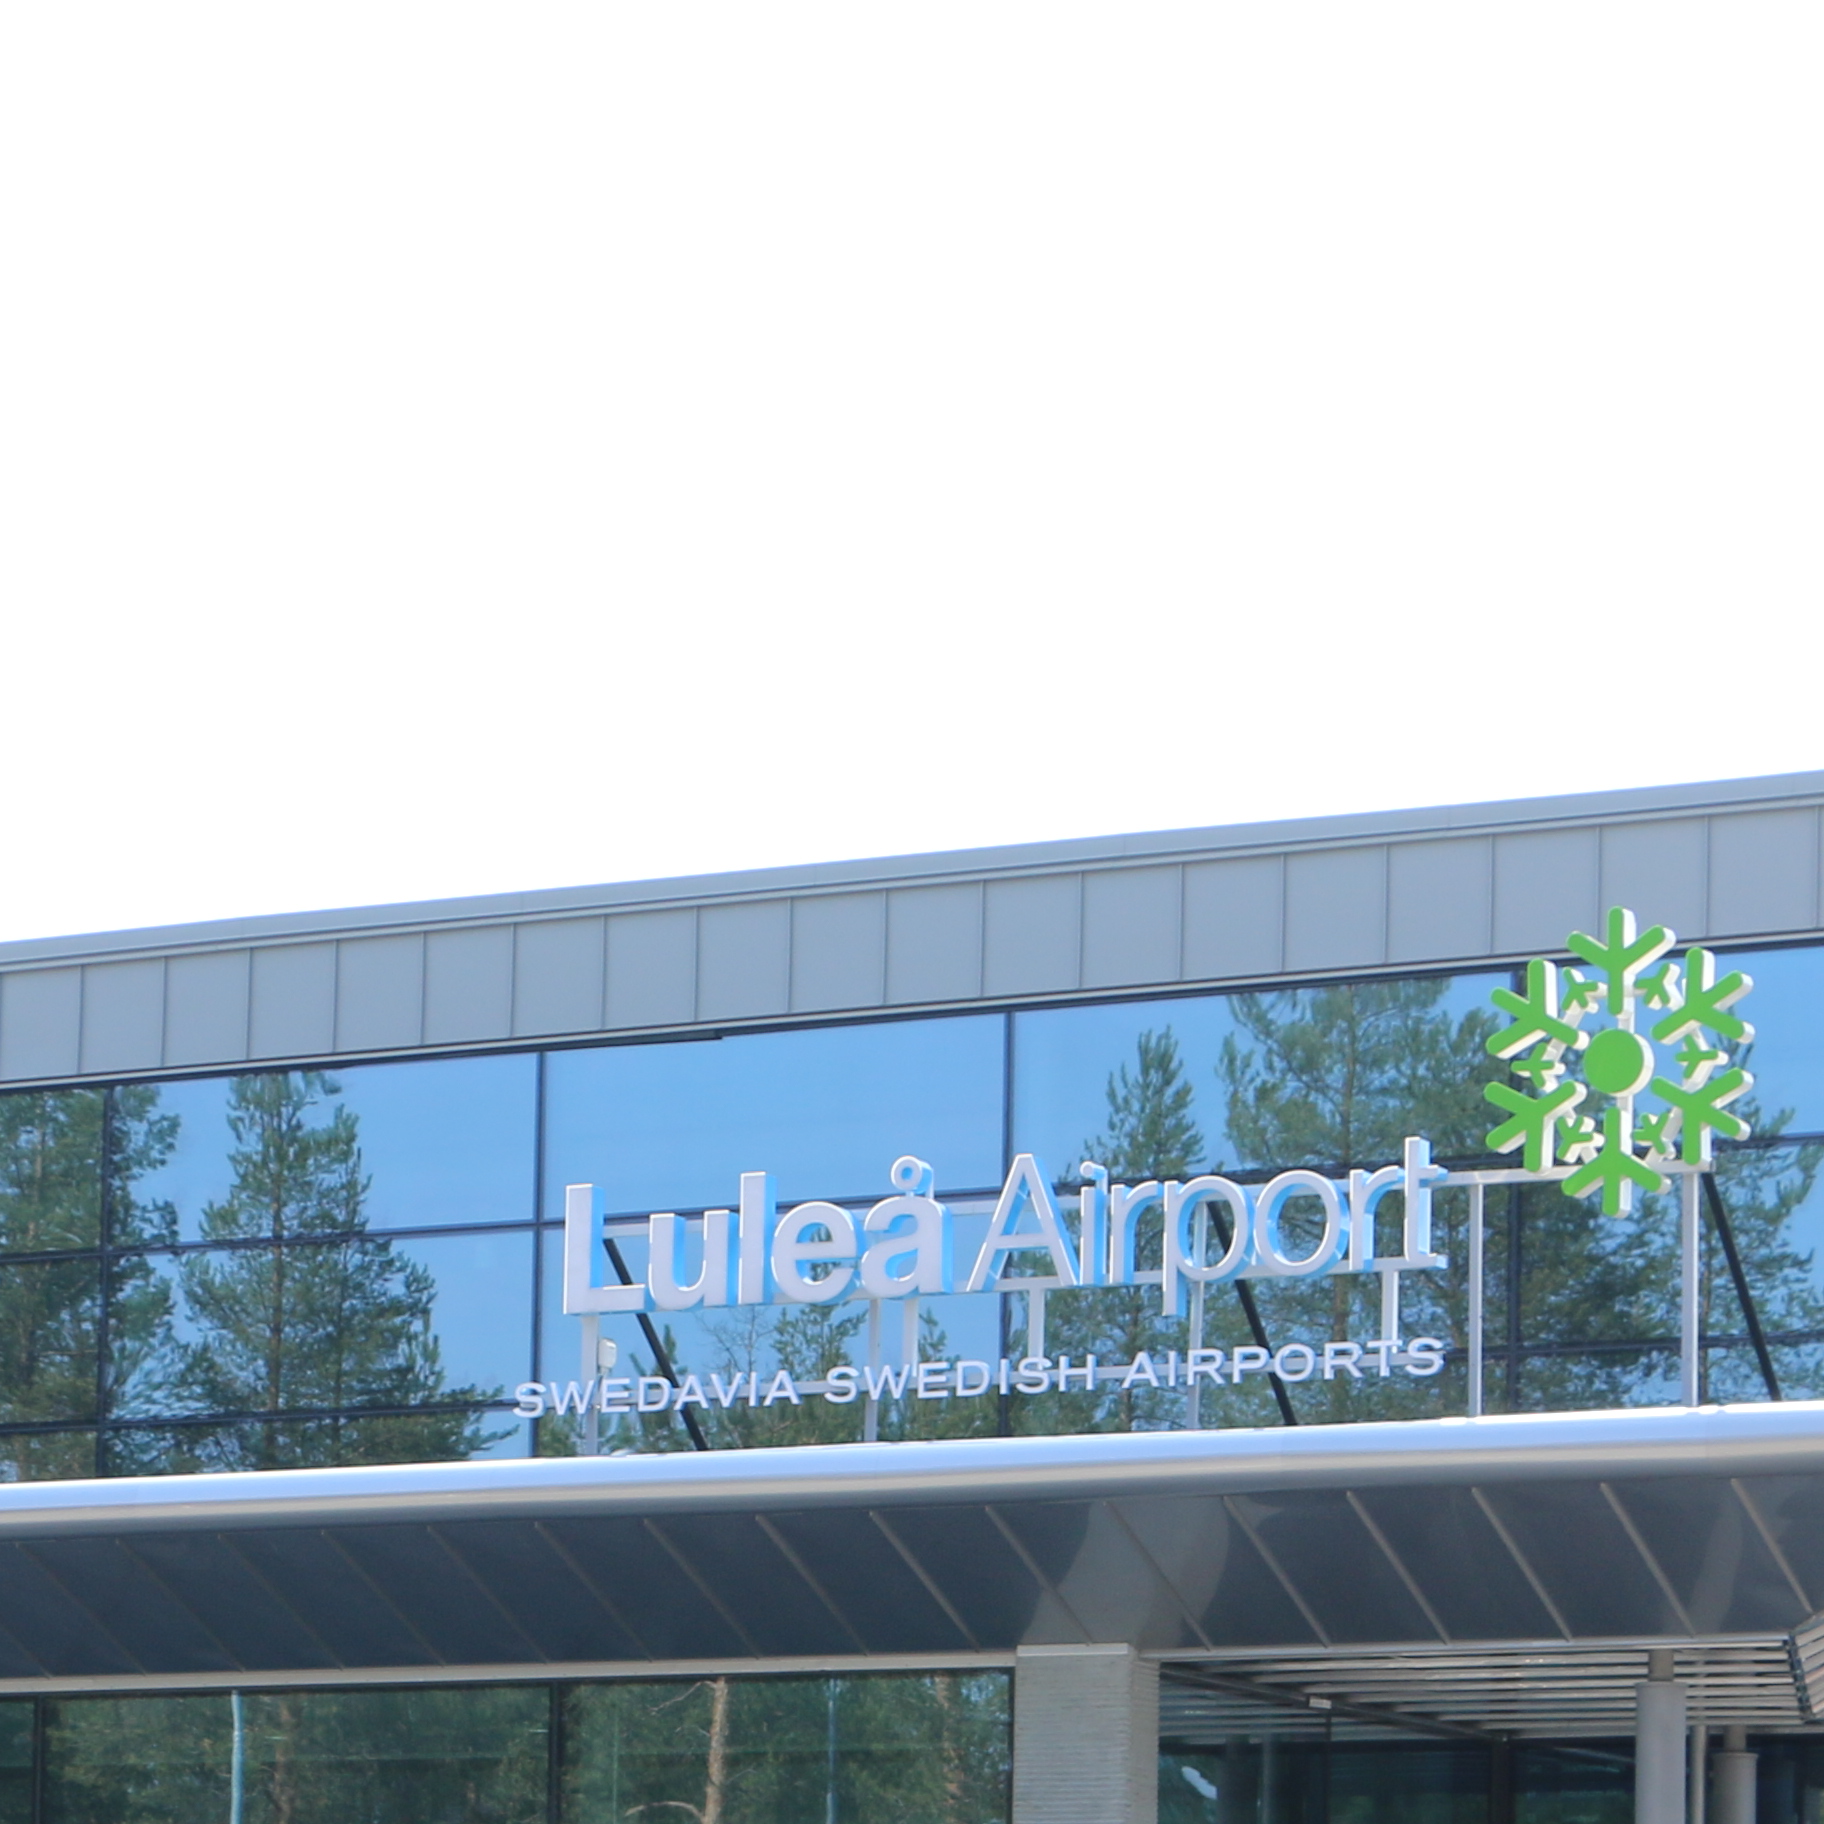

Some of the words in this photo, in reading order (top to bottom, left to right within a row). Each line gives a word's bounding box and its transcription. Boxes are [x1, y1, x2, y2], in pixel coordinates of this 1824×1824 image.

[563, 1155, 953, 1316] Luleå
[966, 1136, 1449, 1317] Airport
[513, 1369, 801, 1419] SWEDAVIA
[824, 1352, 1097, 1404] SWEDISH
[1122, 1337, 1445, 1389] AIRPORTS
